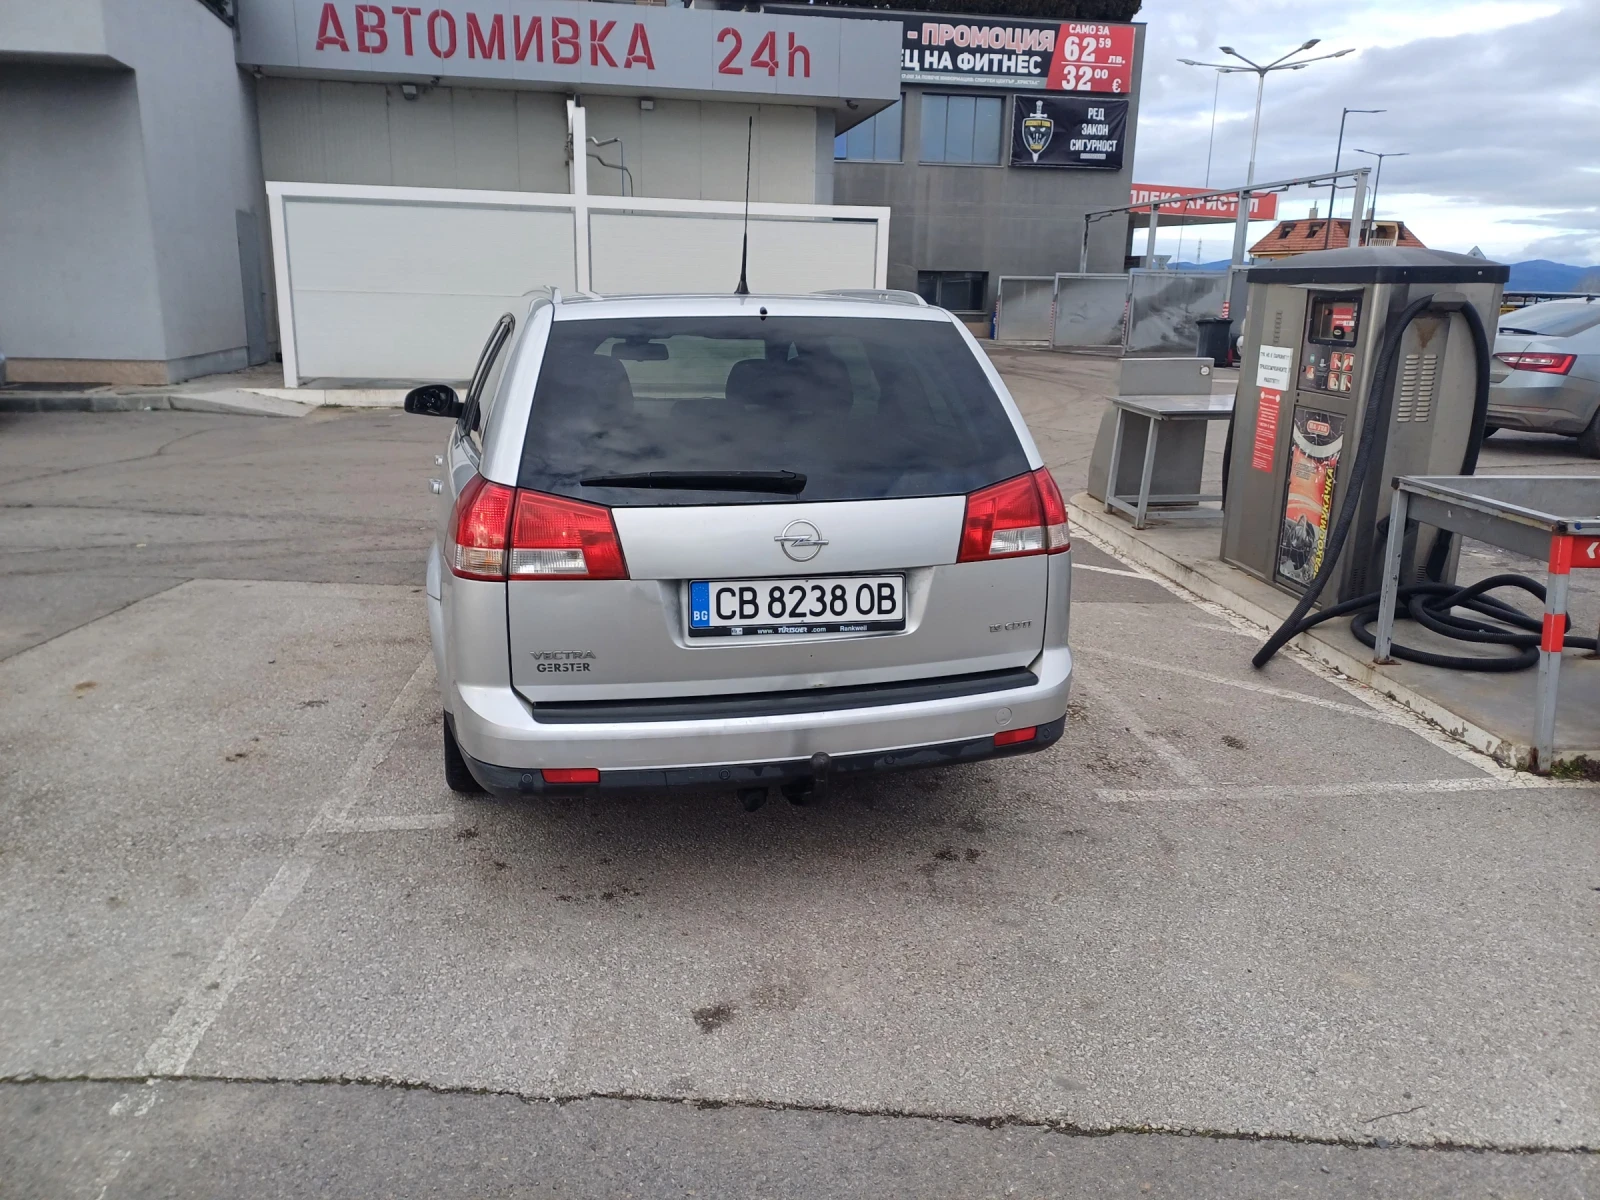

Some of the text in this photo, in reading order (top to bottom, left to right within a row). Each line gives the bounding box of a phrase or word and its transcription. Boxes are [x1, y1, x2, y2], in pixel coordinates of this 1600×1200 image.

[922, 22, 1056, 54] ПРОМОЦИЯ
[1069, 24, 1110, 35] САМО ЗА
[315, 2, 811, 78] АВТОМИВКА 24h
[1064, 35, 1097, 62] 62
[1098, 37, 1112, 48] 59
[901, 49, 1042, 74] Ц НА ФИТНЕС
[1061, 65, 1122, 93] 32 00 €
[1087, 107, 1105, 121] РЕД
[1081, 123, 1109, 136] ЗАКОН
[1069, 139, 1118, 152] СИГУРНОСТ
[693, 582, 897, 621] BG CB 8238 OB
[529, 650, 597, 660] VECTRA
[536, 662, 591, 673] GERSTER
